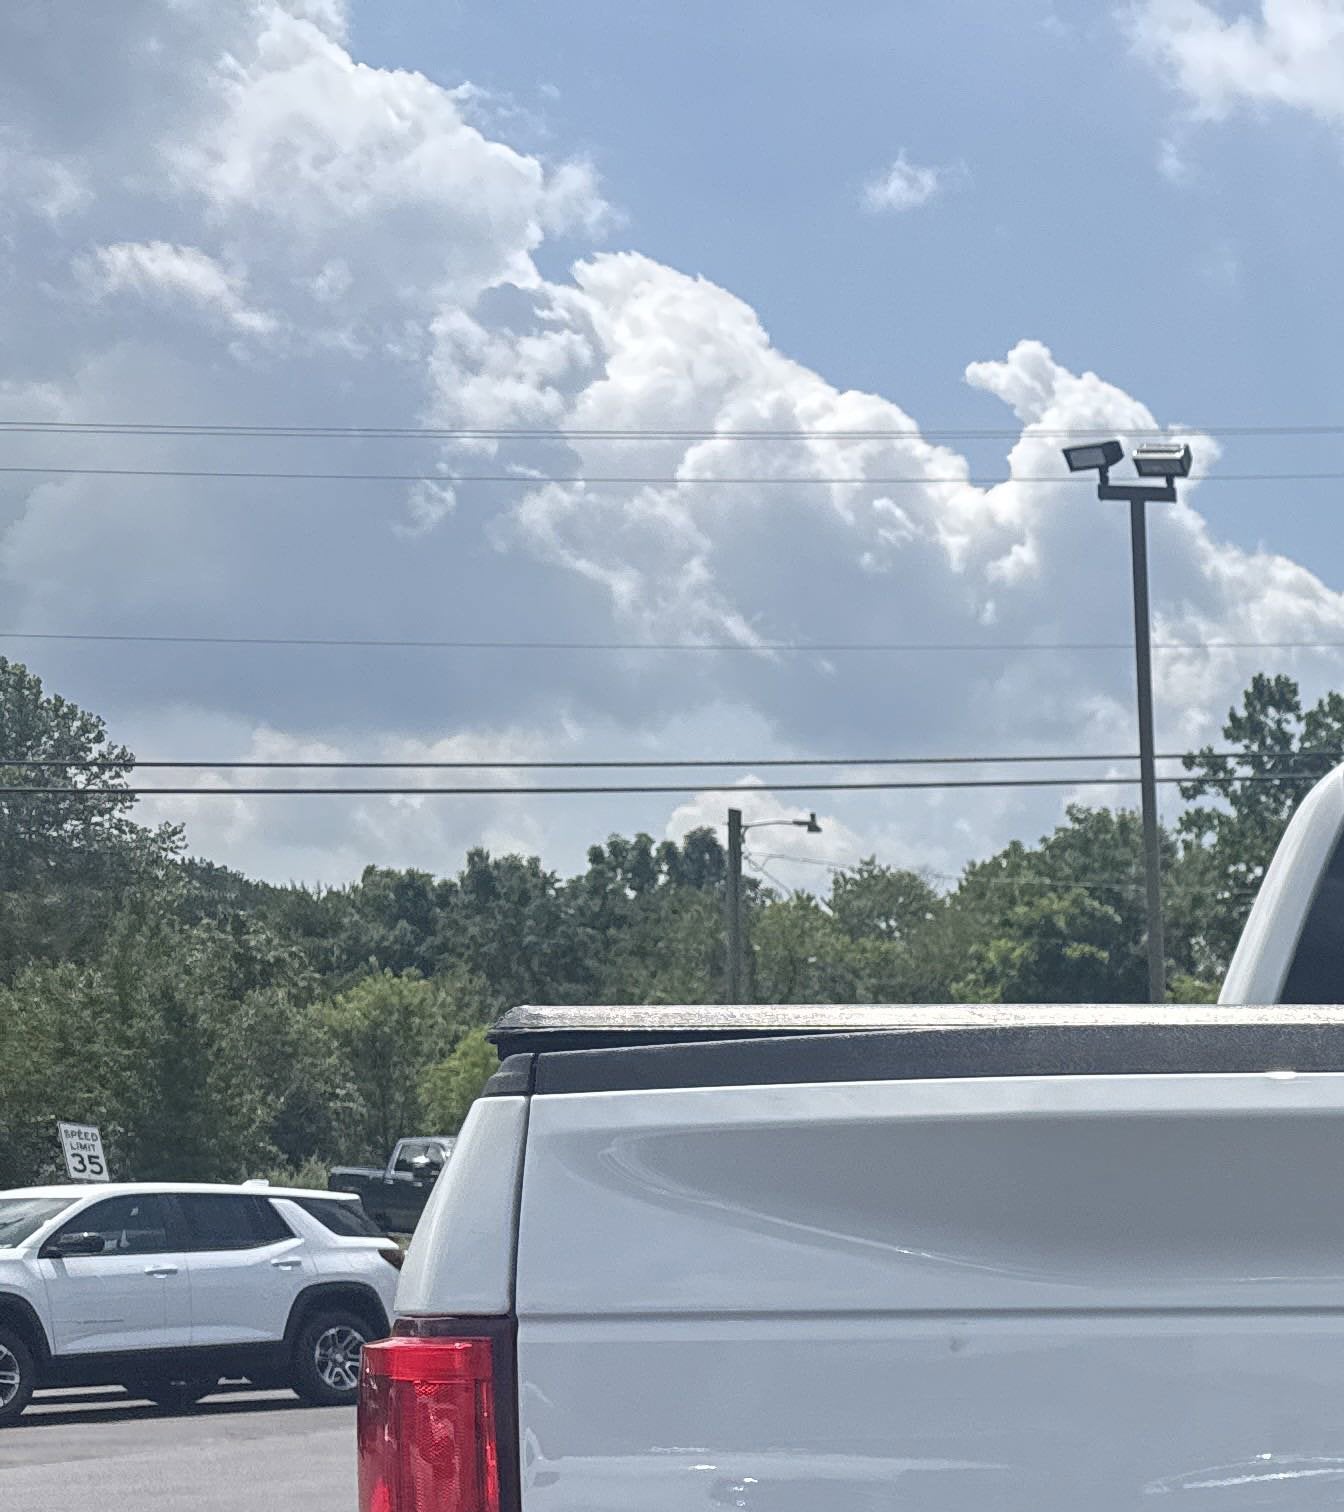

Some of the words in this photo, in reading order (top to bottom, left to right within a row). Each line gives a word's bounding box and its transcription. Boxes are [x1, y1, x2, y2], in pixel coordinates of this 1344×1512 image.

[64, 1129, 99, 1142] SPEED
[70, 1142, 96, 1152] LIMIT
[71, 1153, 104, 1175] 35
